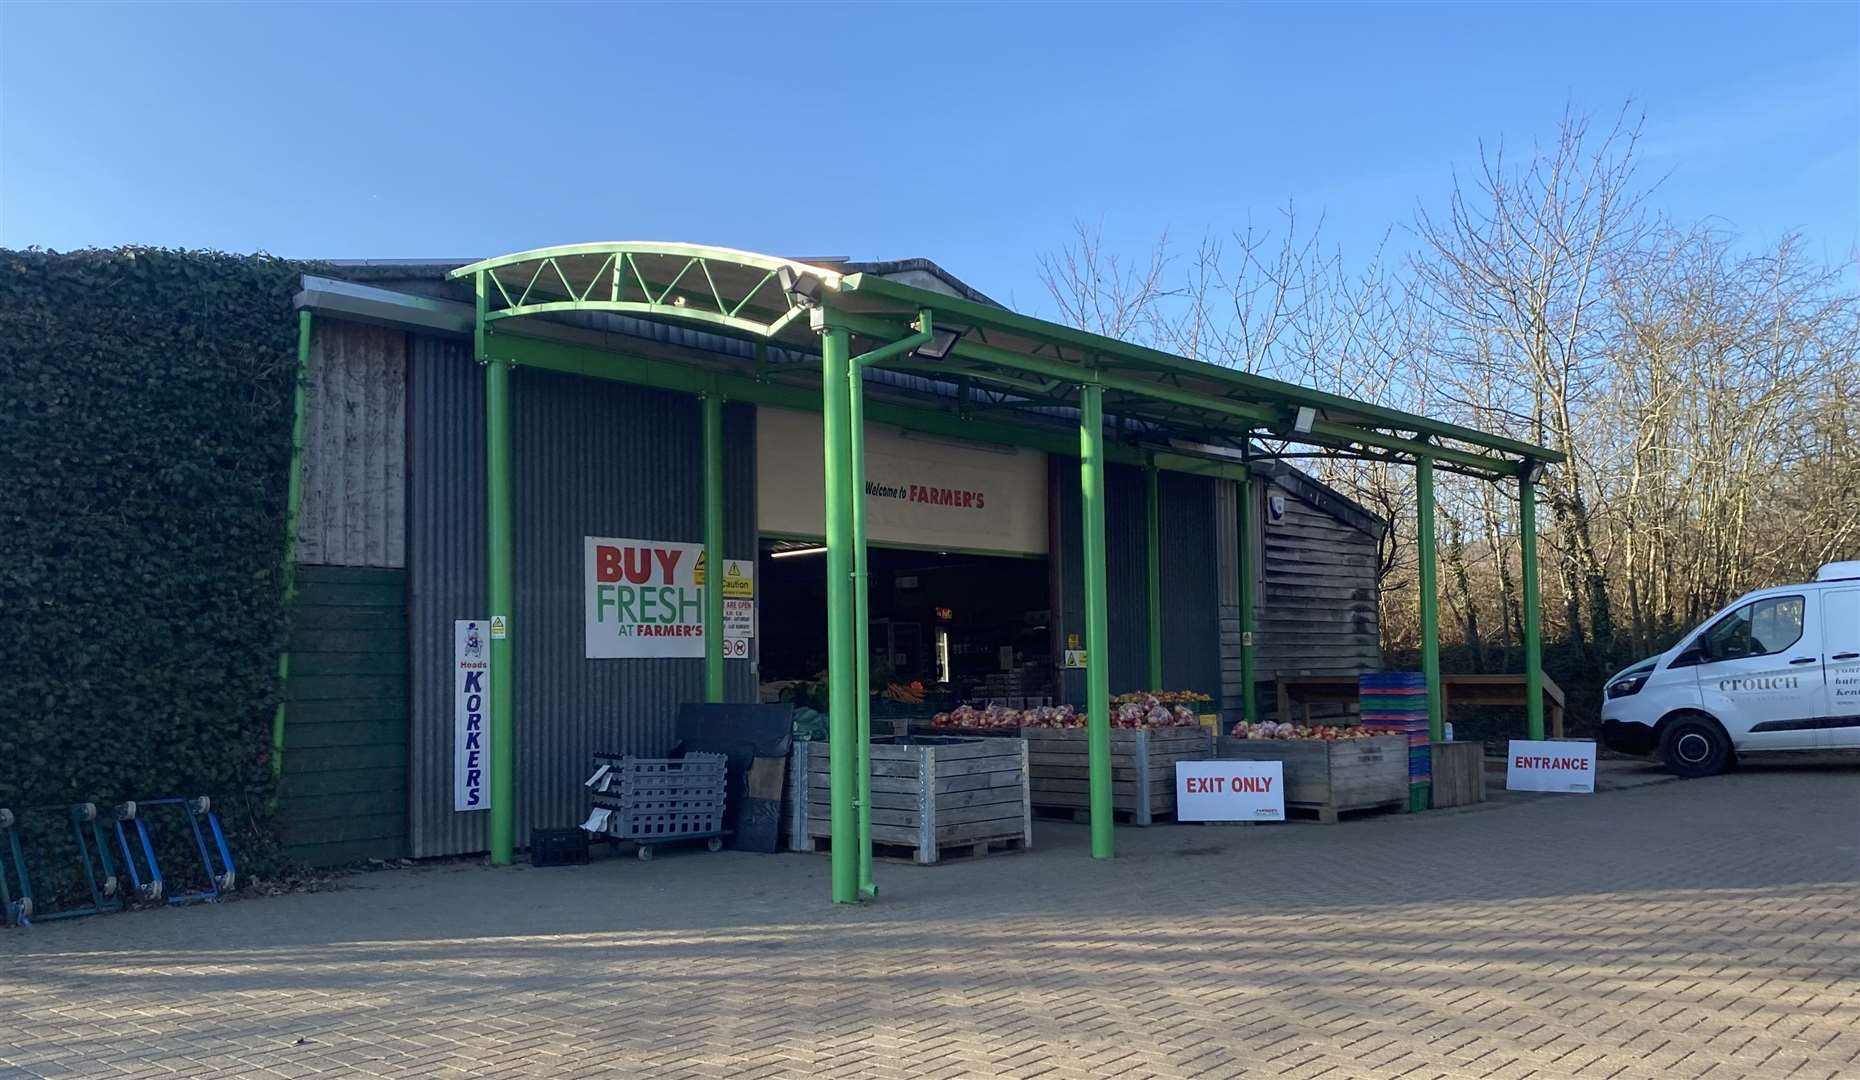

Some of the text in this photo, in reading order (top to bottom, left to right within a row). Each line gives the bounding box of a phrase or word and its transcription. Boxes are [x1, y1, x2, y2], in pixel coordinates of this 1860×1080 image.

[865, 480, 985, 510] Welcome to FARMER'S
[597, 545, 683, 585] BUY
[597, 584, 701, 625] FRESH
[618, 624, 703, 637] AT FARMER'S
[463, 670, 484, 807] KORKERS
[1515, 756, 1588, 770] ENTRANCE
[1186, 776, 1273, 793] EXIT ONLY
